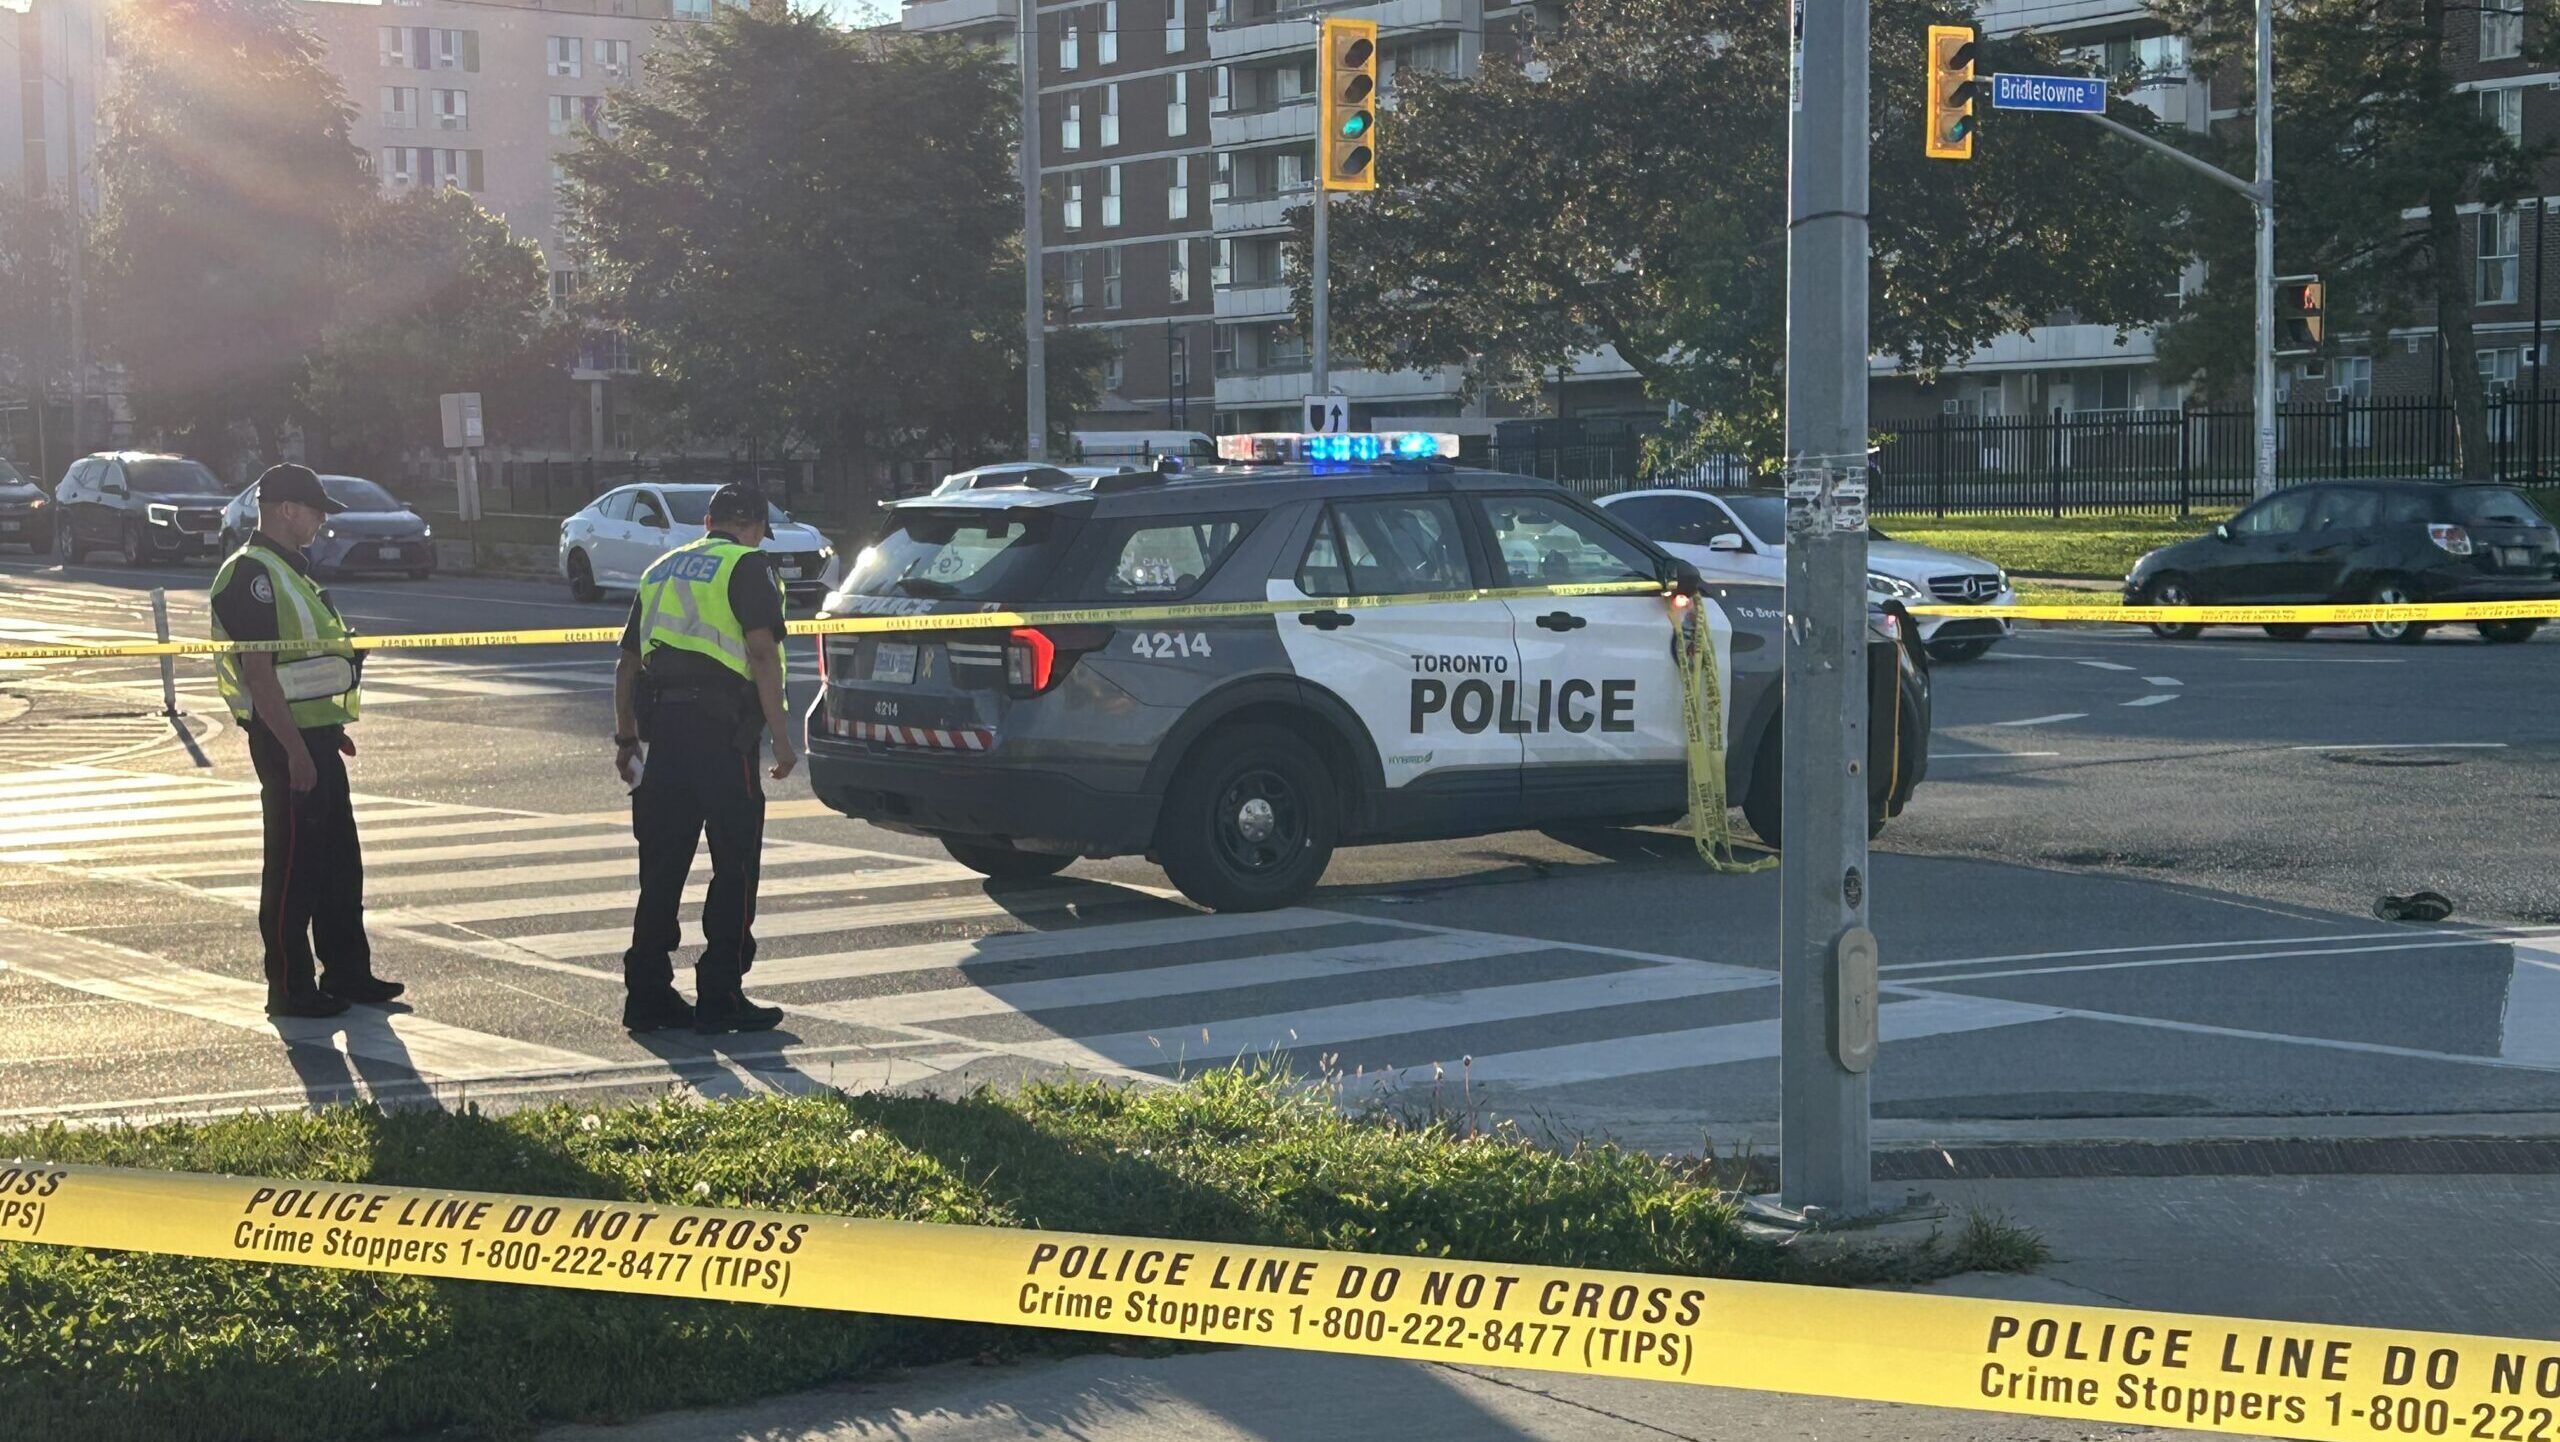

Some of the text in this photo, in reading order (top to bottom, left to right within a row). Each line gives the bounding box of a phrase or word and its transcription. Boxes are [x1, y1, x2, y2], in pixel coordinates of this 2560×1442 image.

[2001, 78, 2084, 103] Bridletowne
[1737, 607, 1754, 618] To
[1131, 632, 1212, 658] 4214
[1411, 655, 1508, 673] TORONTO
[875, 700, 899, 716] 4214
[1410, 679, 1636, 734] POLICE
[245, 1187, 809, 1254] POLICE LINE DO NOT CROSS
[234, 1221, 791, 1298] Crime Stoppers 1-800-222-8477 (TIPS)
[1028, 1243, 1705, 1327] POLICE LINE DO NOT CROSS
[1018, 1282, 1693, 1375] Crime Stoppers 1-800-222-8477 (TIPS)
[1987, 1315, 2560, 1399] POLICE LINE DO NO
[1981, 1362, 2560, 1442] Crime Stoppers 1-800-222
